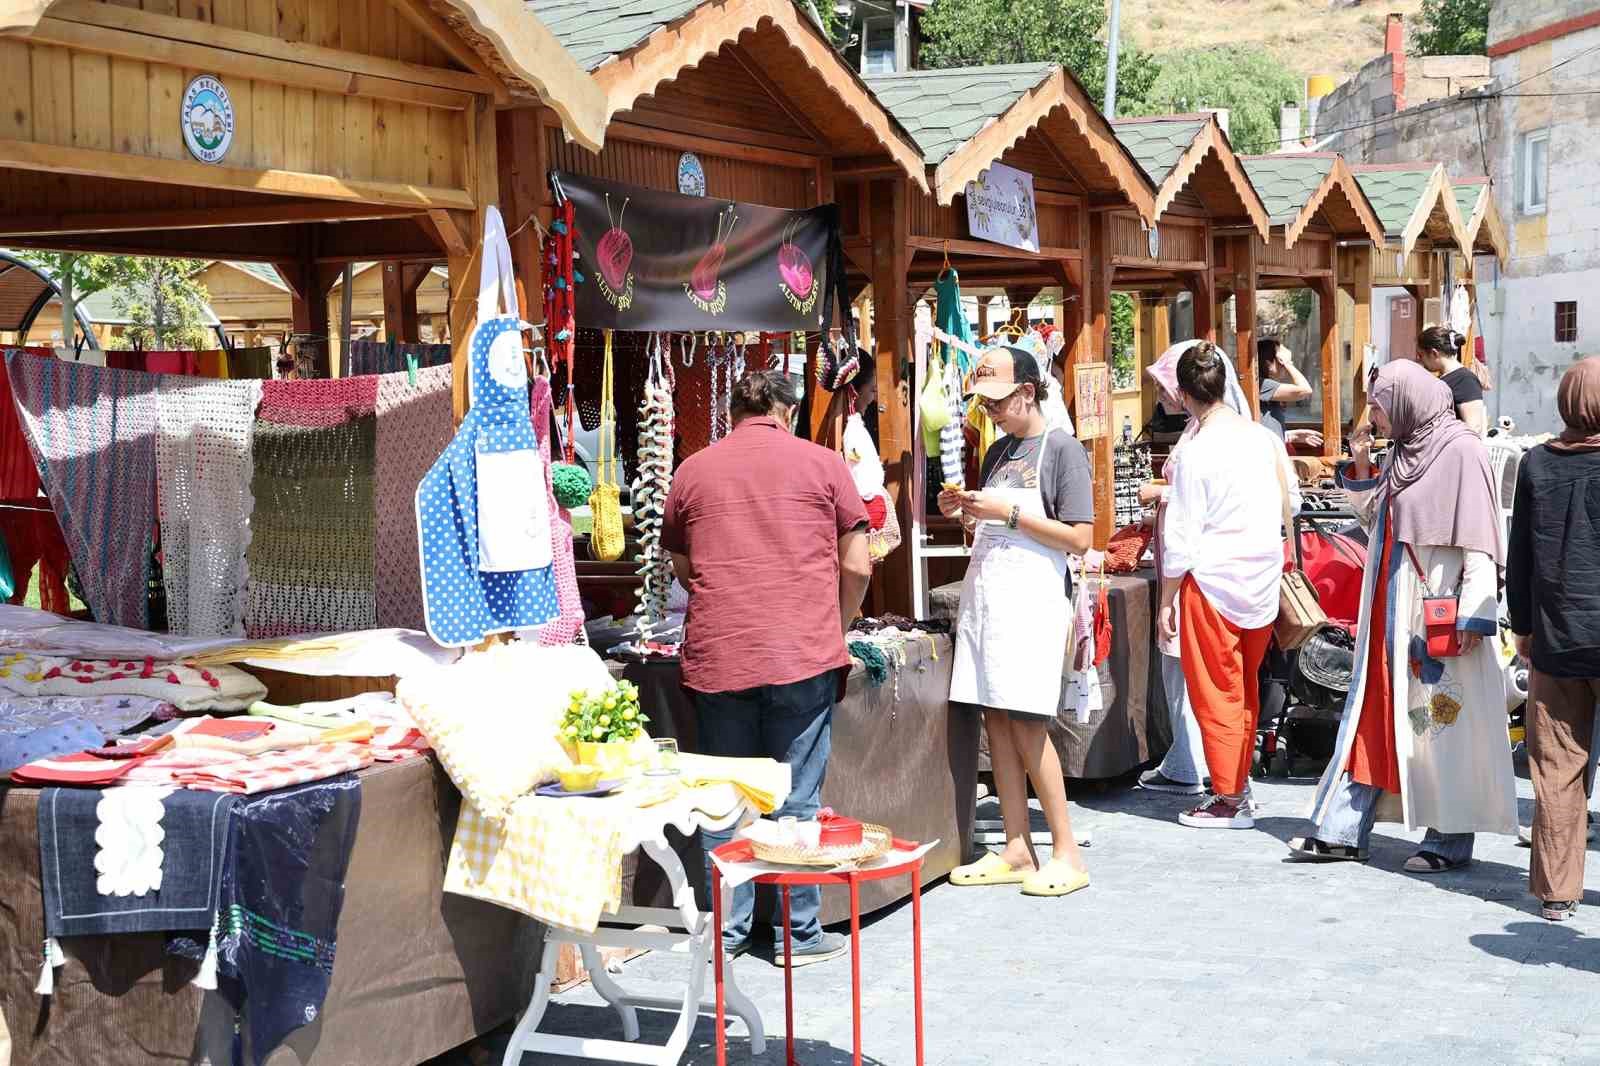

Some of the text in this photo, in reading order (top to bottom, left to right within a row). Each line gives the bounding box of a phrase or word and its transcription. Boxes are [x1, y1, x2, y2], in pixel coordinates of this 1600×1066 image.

[594, 272, 617, 305] ALTIN
[682, 282, 709, 312] ALTIN
[778, 283, 801, 312] ALTIN
